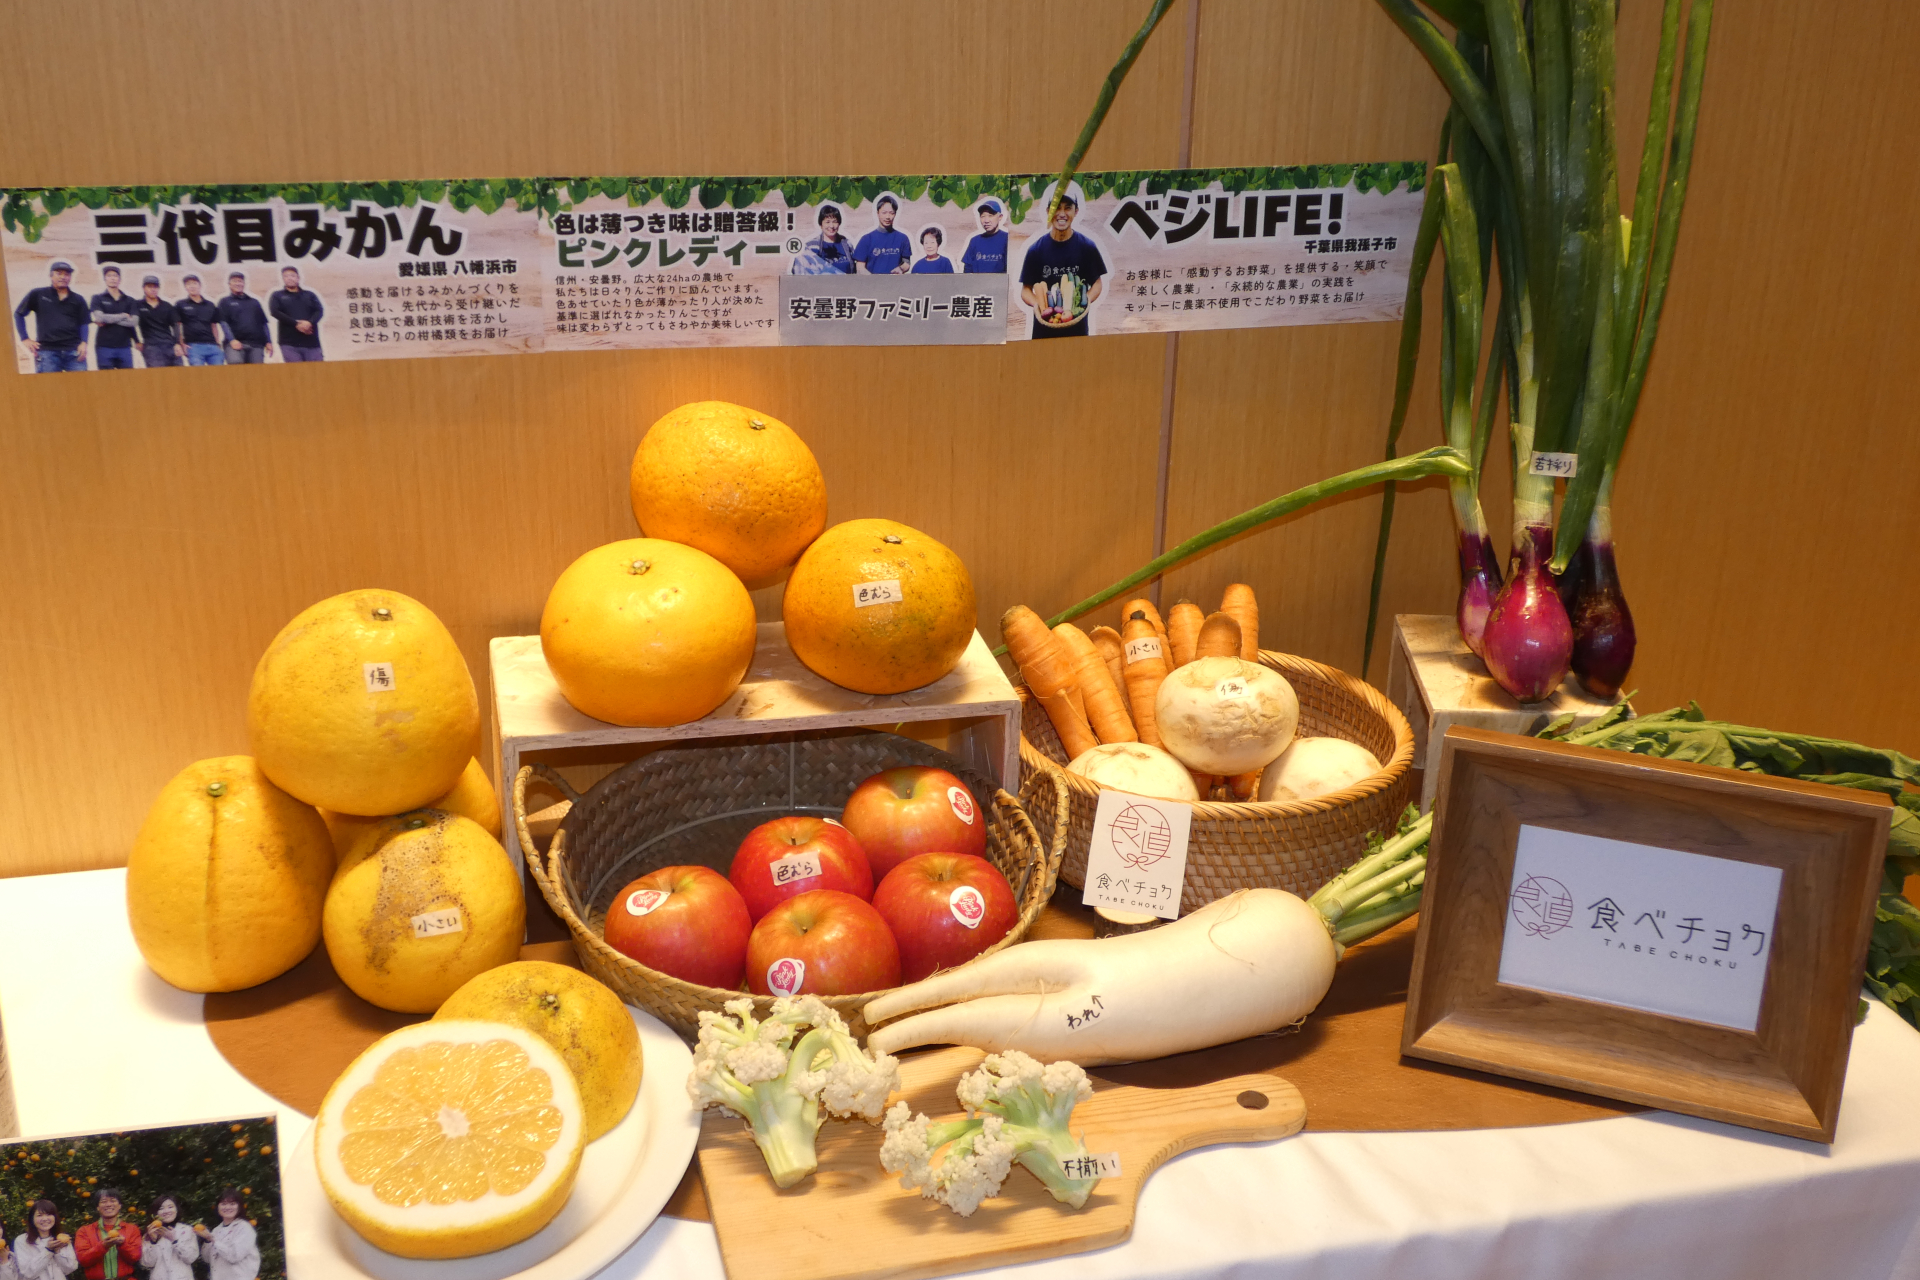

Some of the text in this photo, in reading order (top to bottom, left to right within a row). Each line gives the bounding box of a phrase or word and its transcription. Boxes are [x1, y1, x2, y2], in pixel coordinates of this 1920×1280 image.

[1110, 193, 1344, 244] ベジLIFE!
[95, 205, 463, 265] 三代目みかん
[1304, 237, 1397, 254] 千葉県我孫子市
[399, 259, 517, 277] 愛媛県 八幡浜市
[346, 283, 519, 299] 感動を届けるみかんづくりを
[556, 284, 759, 297] 私たちは日々りんご作りに励んでいます。
[348, 297, 520, 313] 目指し、先代から受け継いだ
[556, 296, 764, 309] 色あせていたり色が薄かったり人が決めた
[790, 296, 993, 320] 安曇野ファミリー農産
[1125, 292, 1364, 312] モットーに農薬不使用でこだわり野菜をお届け
[349, 313, 507, 329] 良園地で最新技術を活かし
[557, 308, 731, 321] 基準に選ばれなかったりんごですが
[557, 319, 774, 332] 味は変わらずとってもさわやか美味しいです
[351, 328, 508, 343] こだわりの柑橘類をお届け
[858, 586, 891, 602] 色むら
[1130, 643, 1159, 656] 小さい
[369, 667, 390, 687] 傷
[777, 861, 813, 882] 色むら
[1095, 872, 1172, 900] 食べチョク
[1098, 894, 1165, 911] TABE CHOKU
[417, 916, 457, 932] 小さい
[1587, 897, 1766, 956] 食べチョク
[1603, 938, 1738, 970] TABE CHOKU
[1066, 1009, 1101, 1029] われ
[1062, 1156, 1116, 1178] 不揃い
